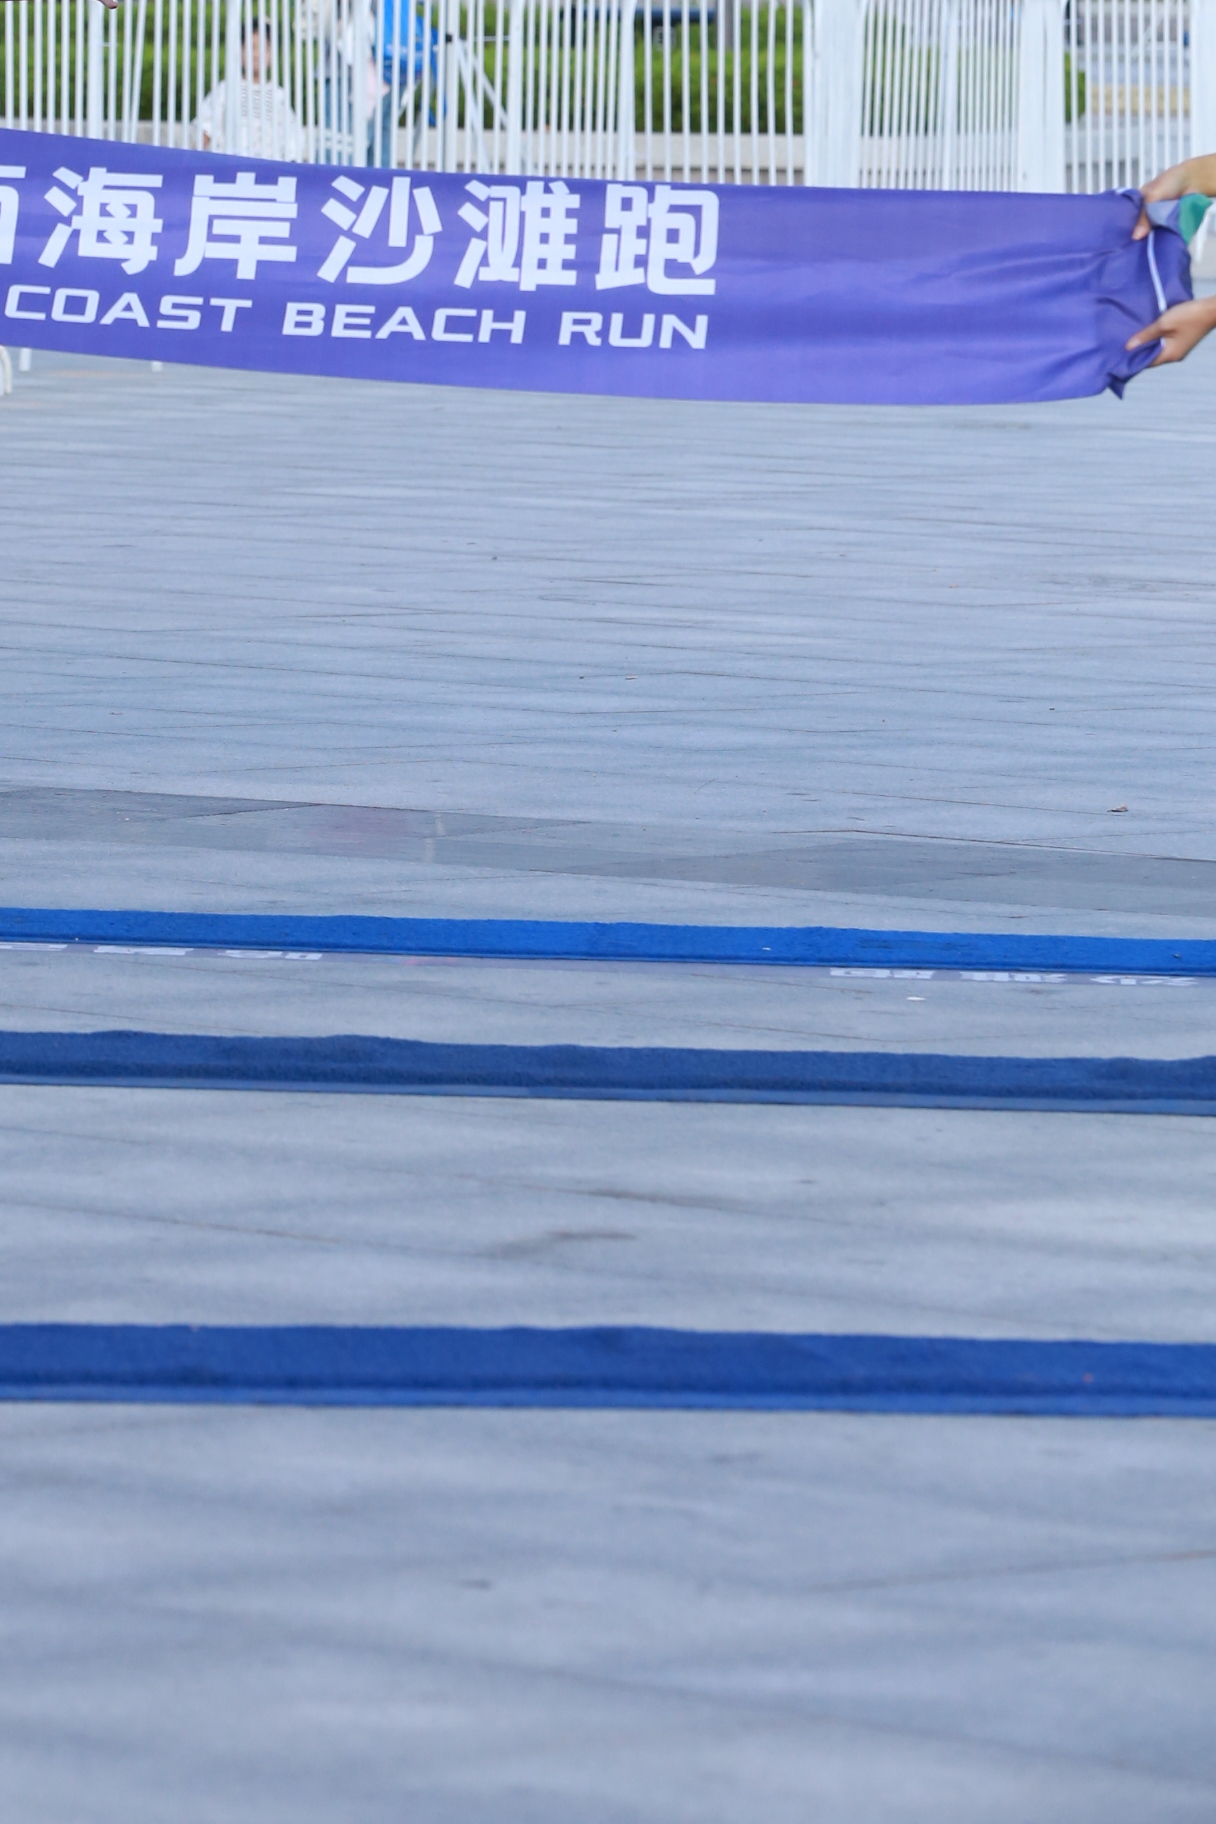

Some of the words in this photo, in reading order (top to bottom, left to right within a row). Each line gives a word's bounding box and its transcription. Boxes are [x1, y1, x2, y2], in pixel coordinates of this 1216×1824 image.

[4, 284, 253, 333] COAST
[282, 301, 526, 345] BEACH
[558, 310, 709, 351] RUN
